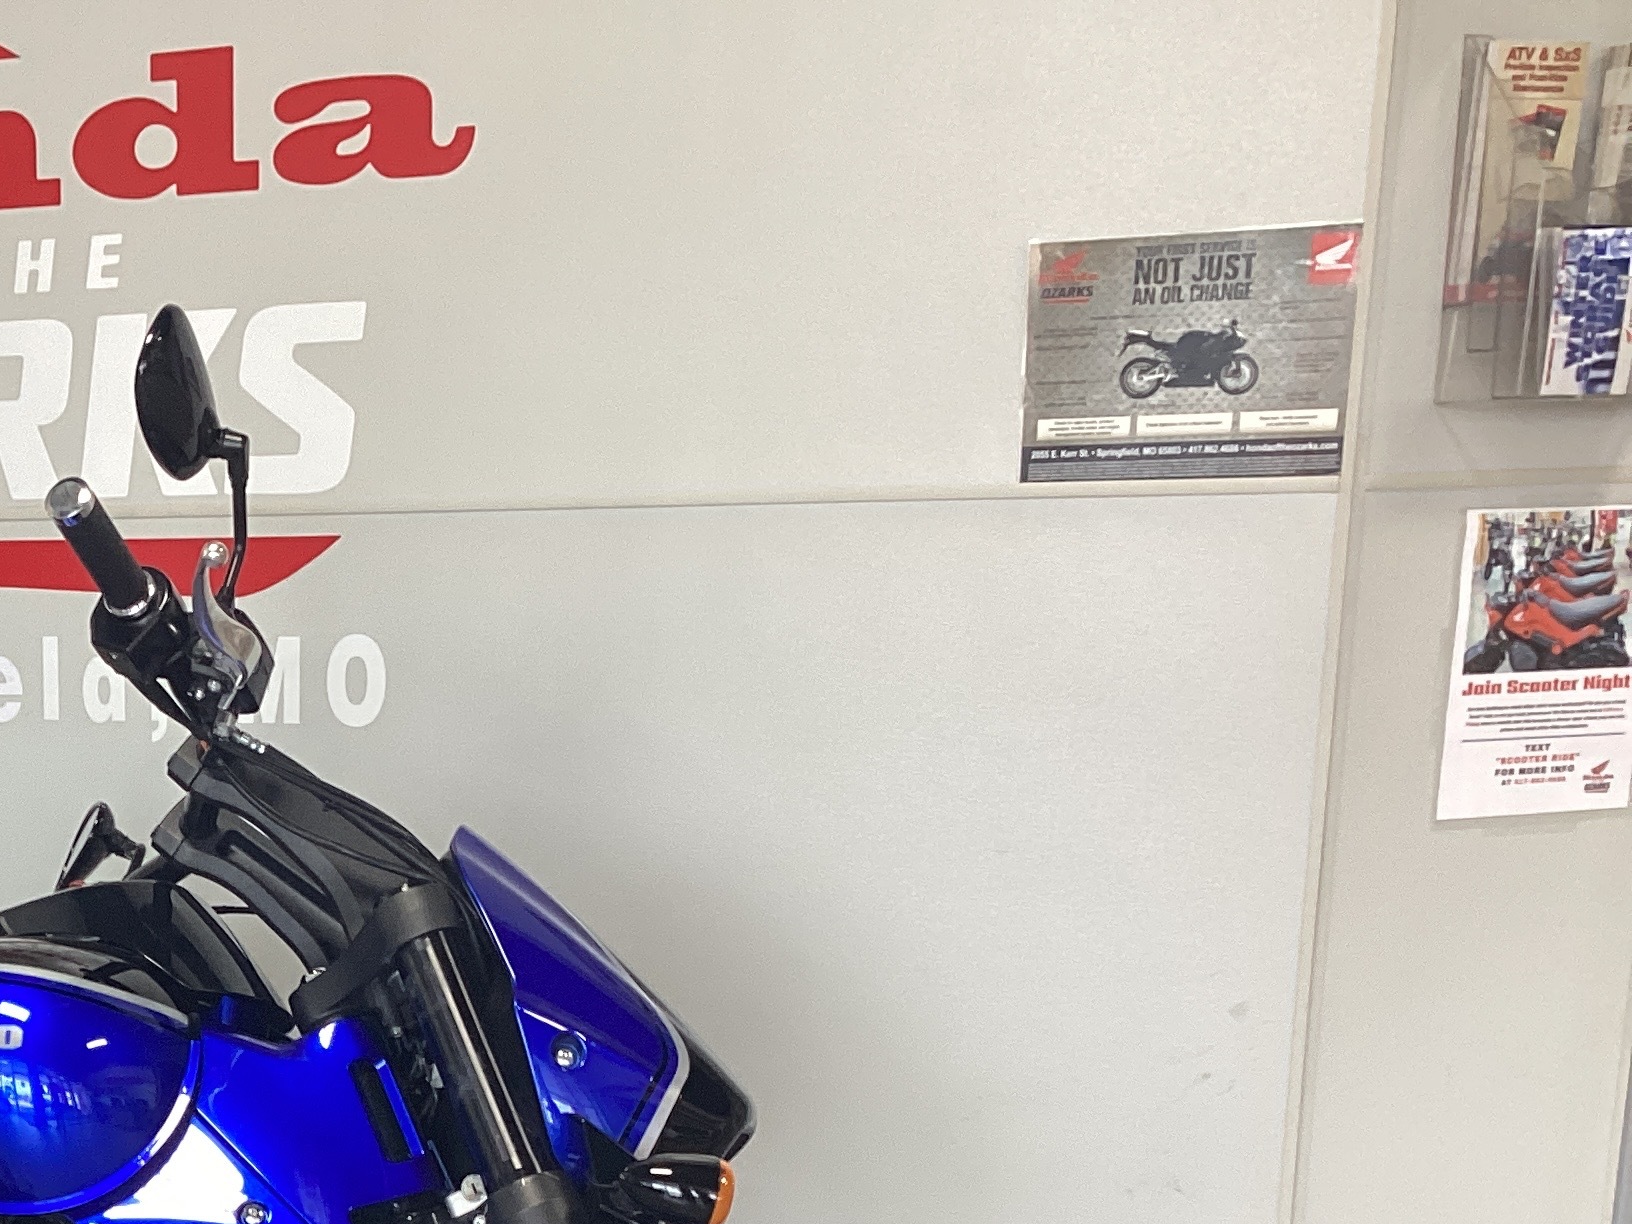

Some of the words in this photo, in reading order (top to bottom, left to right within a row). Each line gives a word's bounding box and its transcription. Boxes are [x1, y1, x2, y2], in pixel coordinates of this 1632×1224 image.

[1507, 46, 1536, 61] ATV
[1554, 46, 1582, 62] SxS
[1133, 257, 1184, 285] NOT
[1192, 252, 1257, 281] JUST
[1040, 285, 1094, 298] OZARKS
[1132, 287, 1156, 305] AN
[1160, 285, 1185, 304] OIL
[1189, 281, 1254, 303] CHANGE
[1462, 680, 1502, 696] Join
[1507, 678, 1579, 694] Scooter
[1583, 674, 1631, 692] Night
[1525, 743, 1551, 752] TEXT
[1494, 768, 1515, 776] FOR
[1518, 766, 1547, 775] MORE
[1551, 764, 1575, 773] INFO
